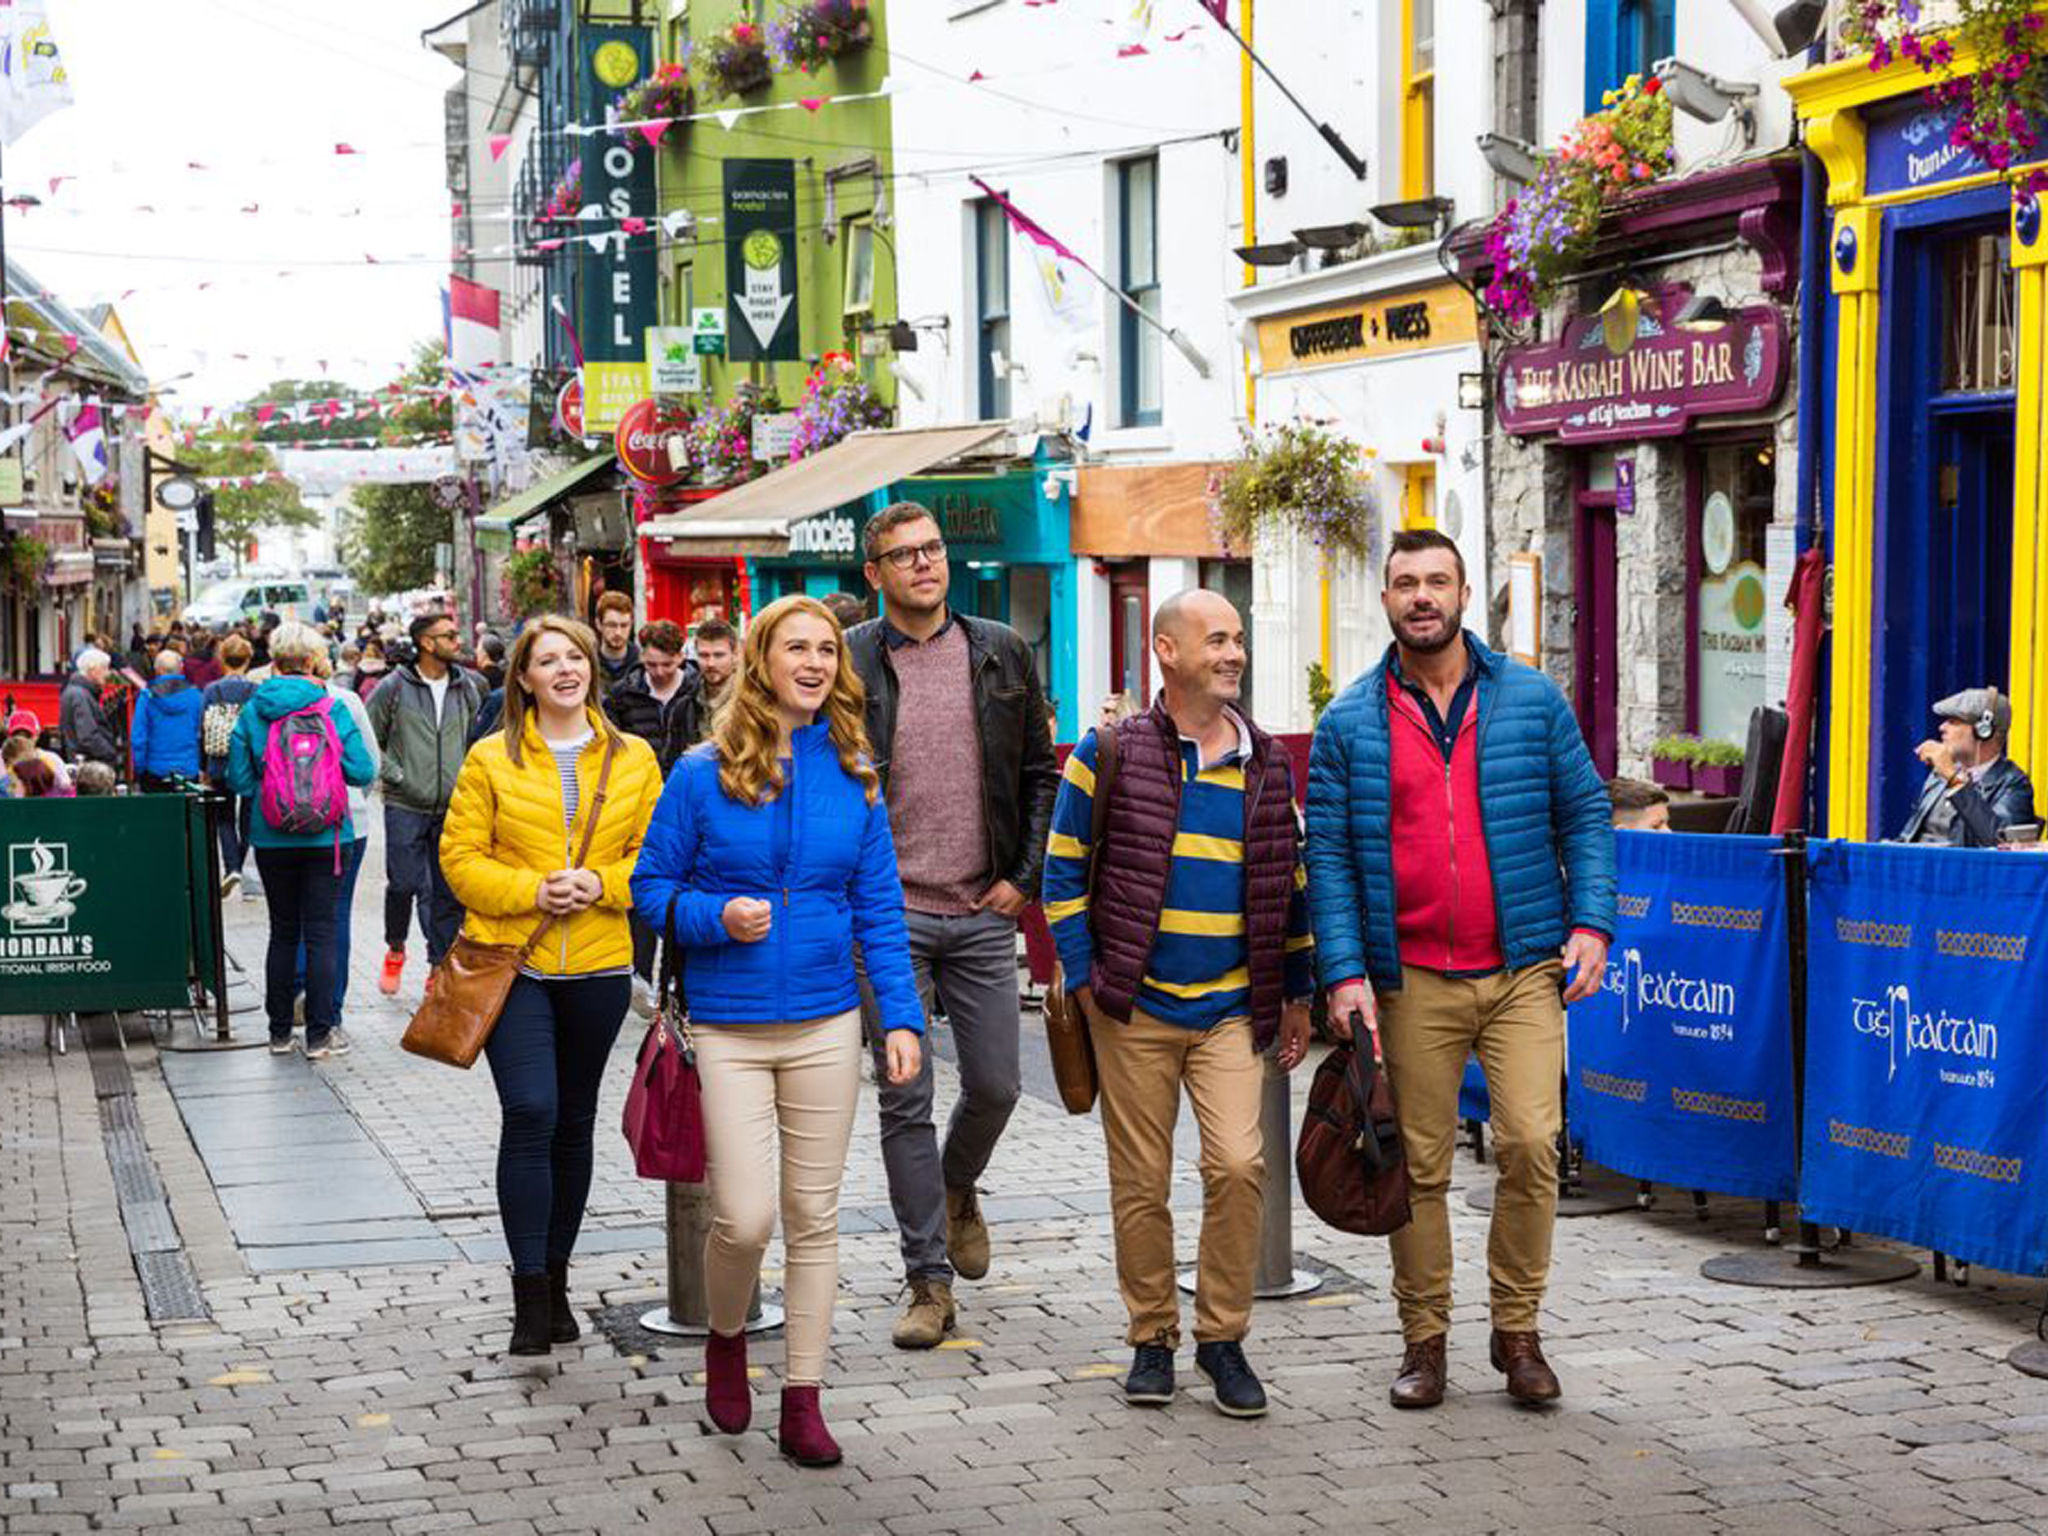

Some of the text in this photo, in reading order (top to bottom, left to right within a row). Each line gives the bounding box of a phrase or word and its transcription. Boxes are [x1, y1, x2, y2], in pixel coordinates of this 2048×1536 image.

[1557, 358, 1624, 403] KASBAH
[1629, 349, 1685, 394] WINE
[1691, 341, 1734, 387] BAR
[46, 962, 75, 972] IRISH
[77, 960, 111, 972] FOOD
